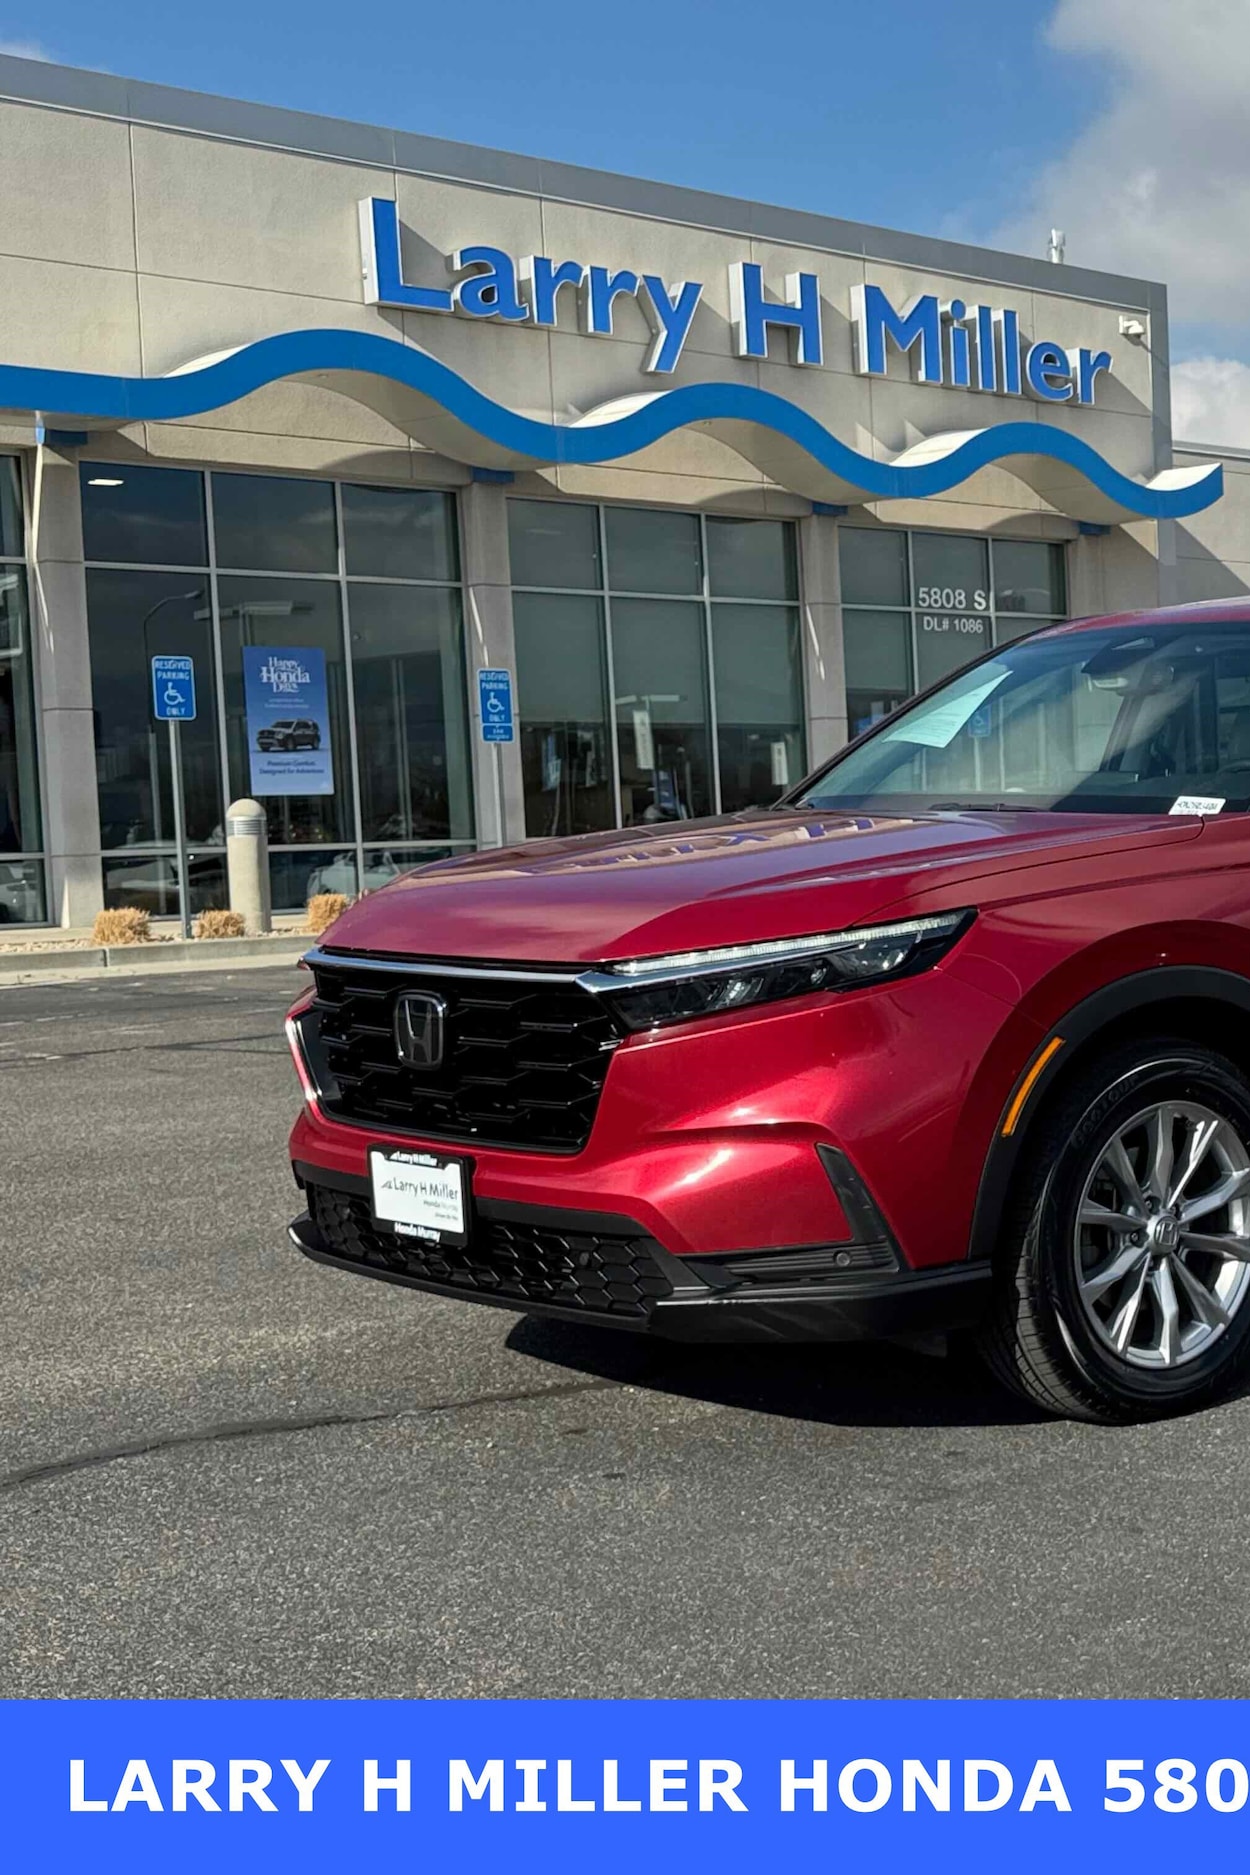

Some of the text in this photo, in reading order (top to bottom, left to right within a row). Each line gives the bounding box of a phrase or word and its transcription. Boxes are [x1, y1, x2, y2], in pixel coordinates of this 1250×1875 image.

[358, 197, 1113, 405] Larry H Miller
[918, 587, 987, 610] 5808 S
[923, 616, 984, 633] DL# 1086
[268, 656, 298, 670] Happy
[157, 671, 190, 680] PARKING
[260, 666, 310, 683] Honda
[393, 1177, 459, 1200] Larry H Miller
